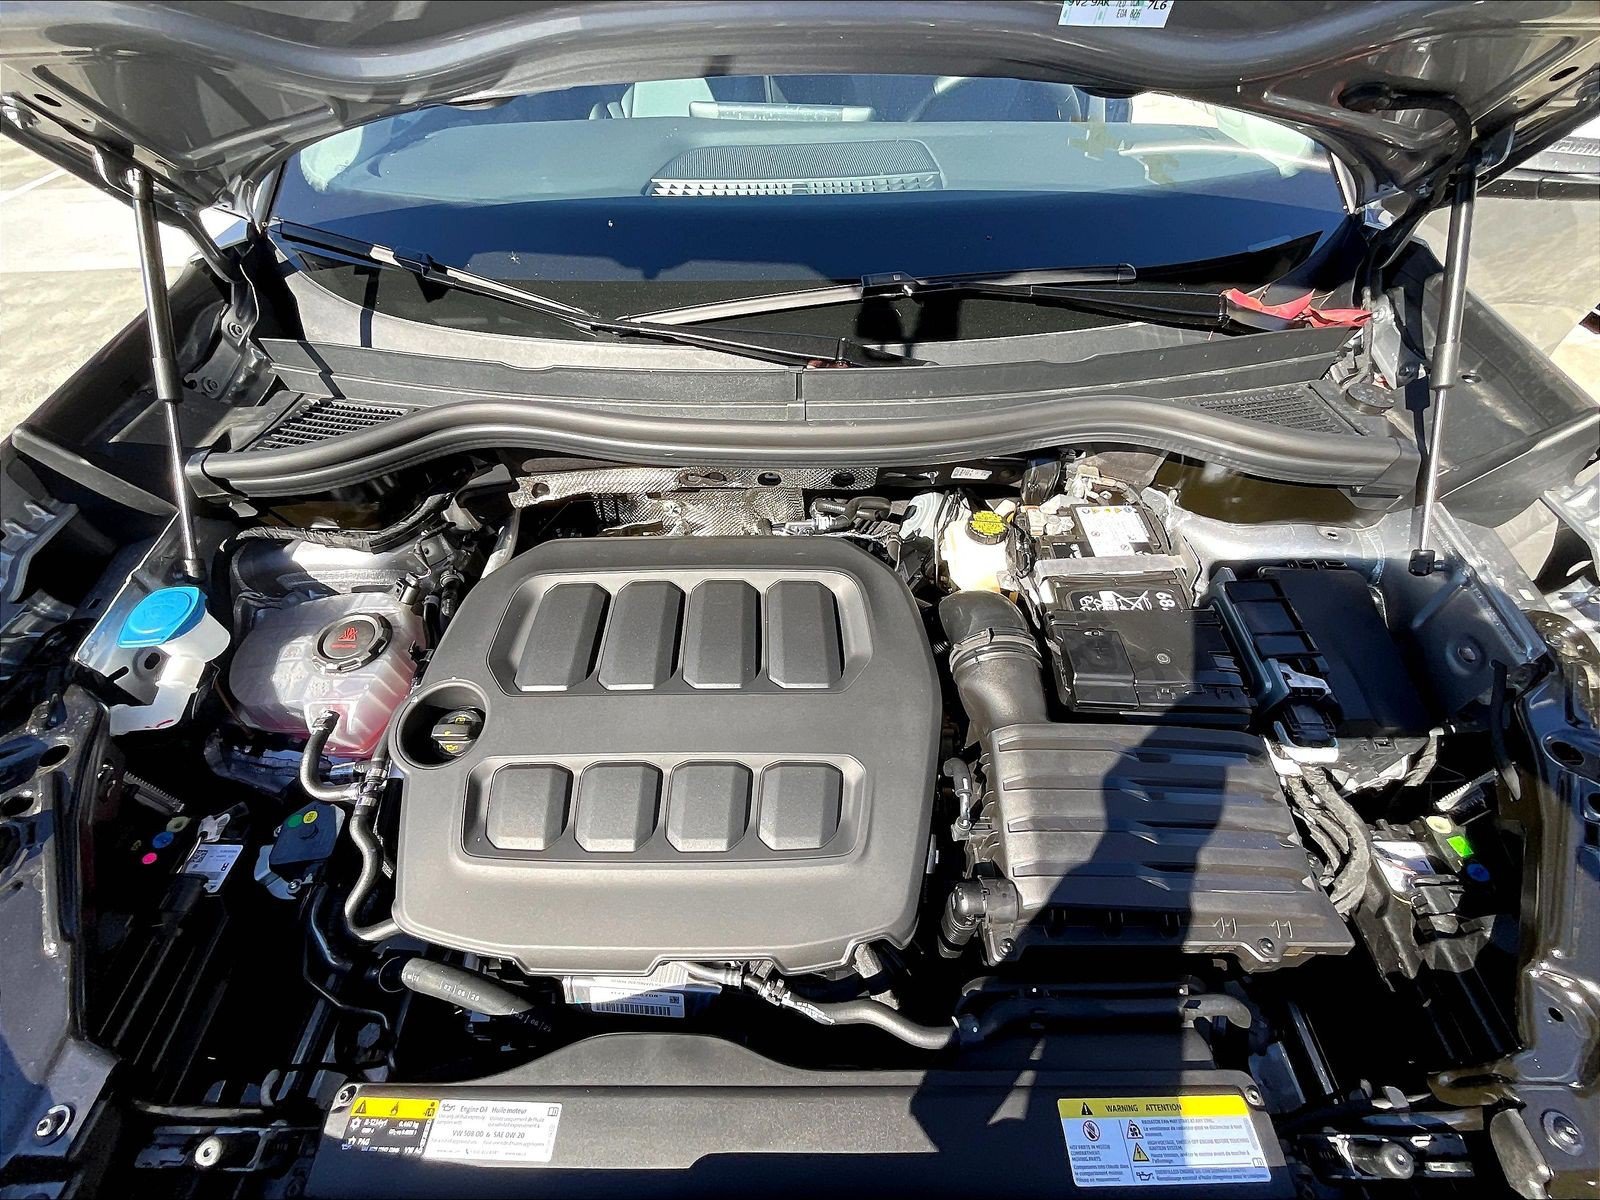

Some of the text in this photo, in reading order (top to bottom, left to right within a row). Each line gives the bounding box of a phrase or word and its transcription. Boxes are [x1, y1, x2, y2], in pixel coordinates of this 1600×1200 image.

[460, 1105, 479, 1114] Engine
[1105, 1103, 1182, 1112] WARNING ATTENTION
